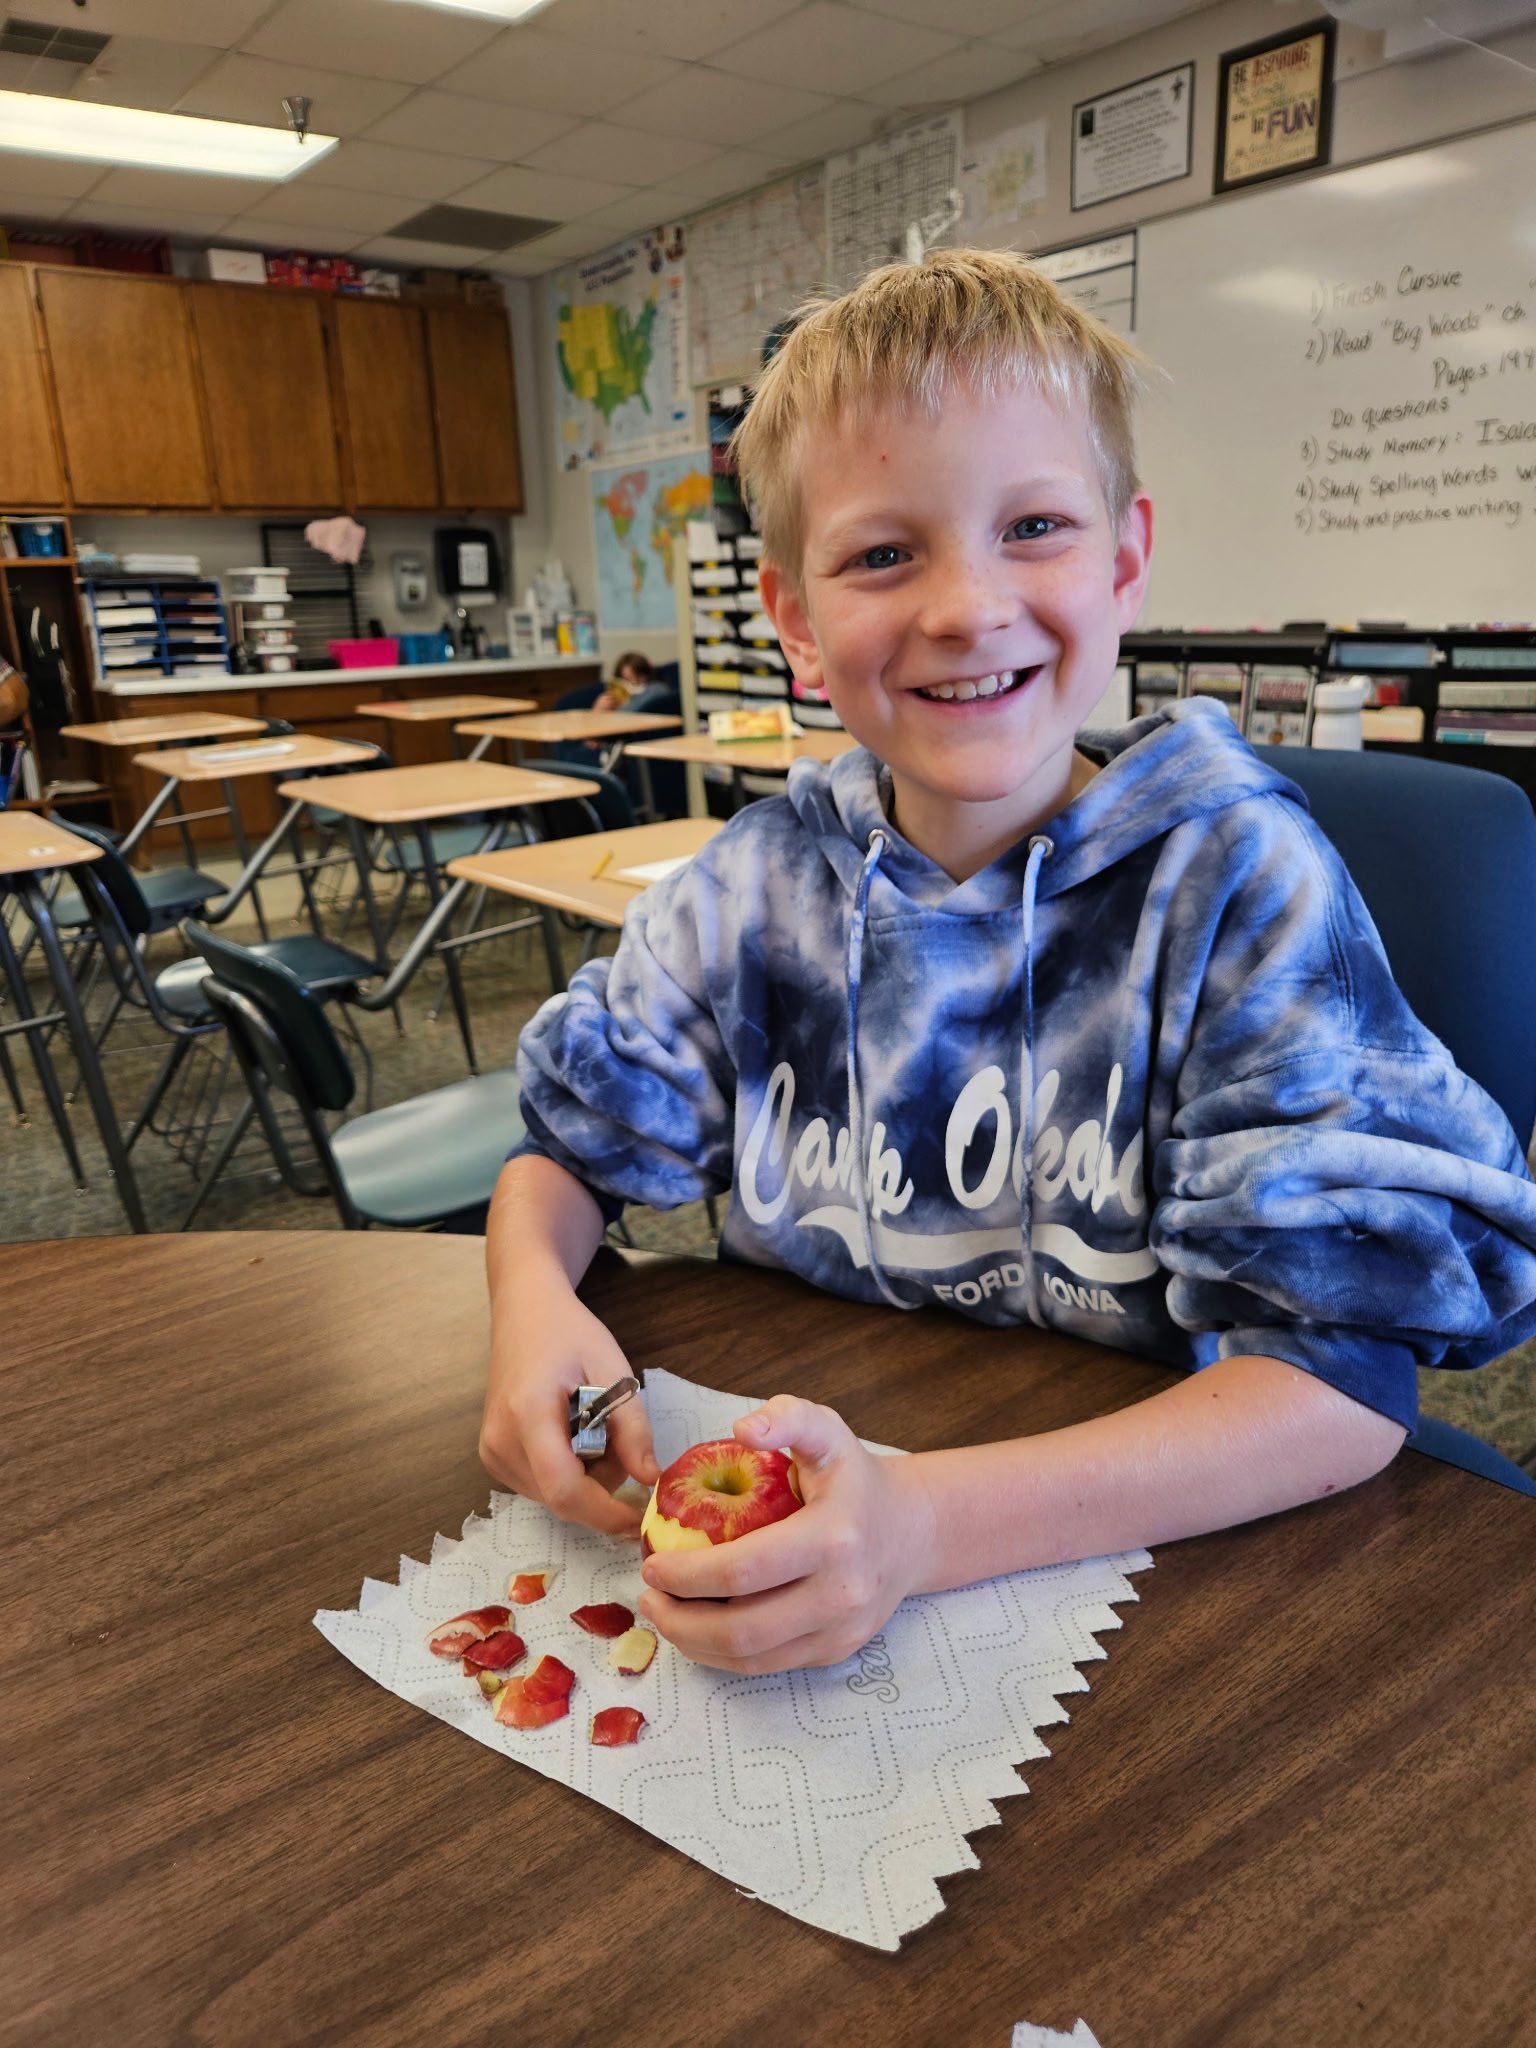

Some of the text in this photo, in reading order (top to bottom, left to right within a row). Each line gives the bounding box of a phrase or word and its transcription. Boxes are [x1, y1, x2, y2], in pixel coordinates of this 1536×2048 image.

[1266, 97, 1318, 140] FUN
[1397, 265, 1463, 295] Cursive
[1331, 327, 1373, 358] Read
[1432, 357, 1488, 395] Pages
[1330, 396, 1450, 432] Do questions
[1327, 441, 1372, 464] Study
[1319, 477, 1361, 505] Study
[1369, 471, 1438, 499] Spelling
[1318, 508, 1360, 533] Study
[1365, 505, 1389, 526] and
[1392, 503, 1451, 529] practice
[1455, 499, 1521, 529] writing
[1043, 1271, 1127, 1315] IOWA
